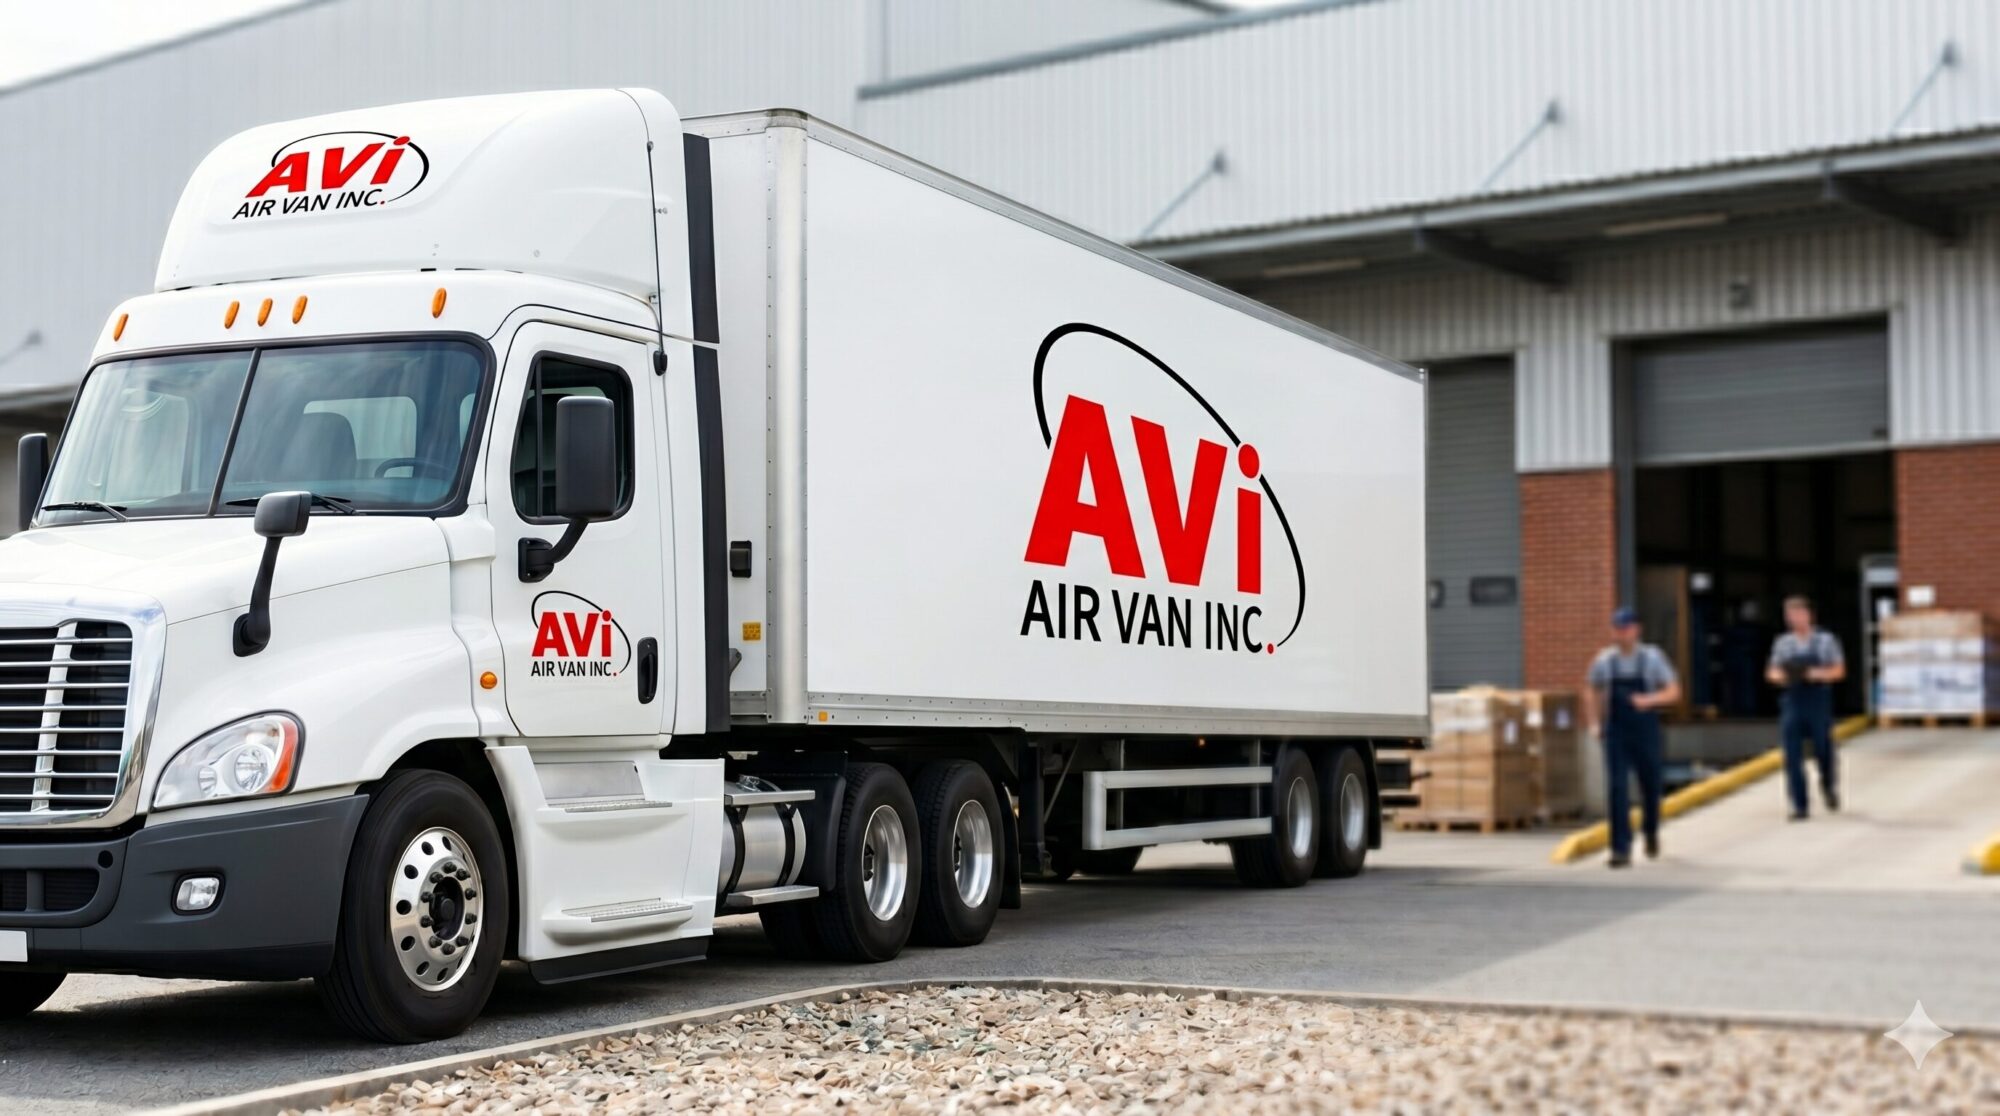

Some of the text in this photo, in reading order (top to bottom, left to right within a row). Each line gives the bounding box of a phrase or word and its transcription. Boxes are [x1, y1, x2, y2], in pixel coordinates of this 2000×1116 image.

[245, 136, 410, 198] AVi
[232, 189, 385, 219] AIR VAN INC.
[1024, 394, 1261, 595] AVi
[531, 610, 612, 657] AVi
[1020, 579, 1274, 655] AIR VAN INC.
[531, 661, 617, 677] AIR VAN INC.
